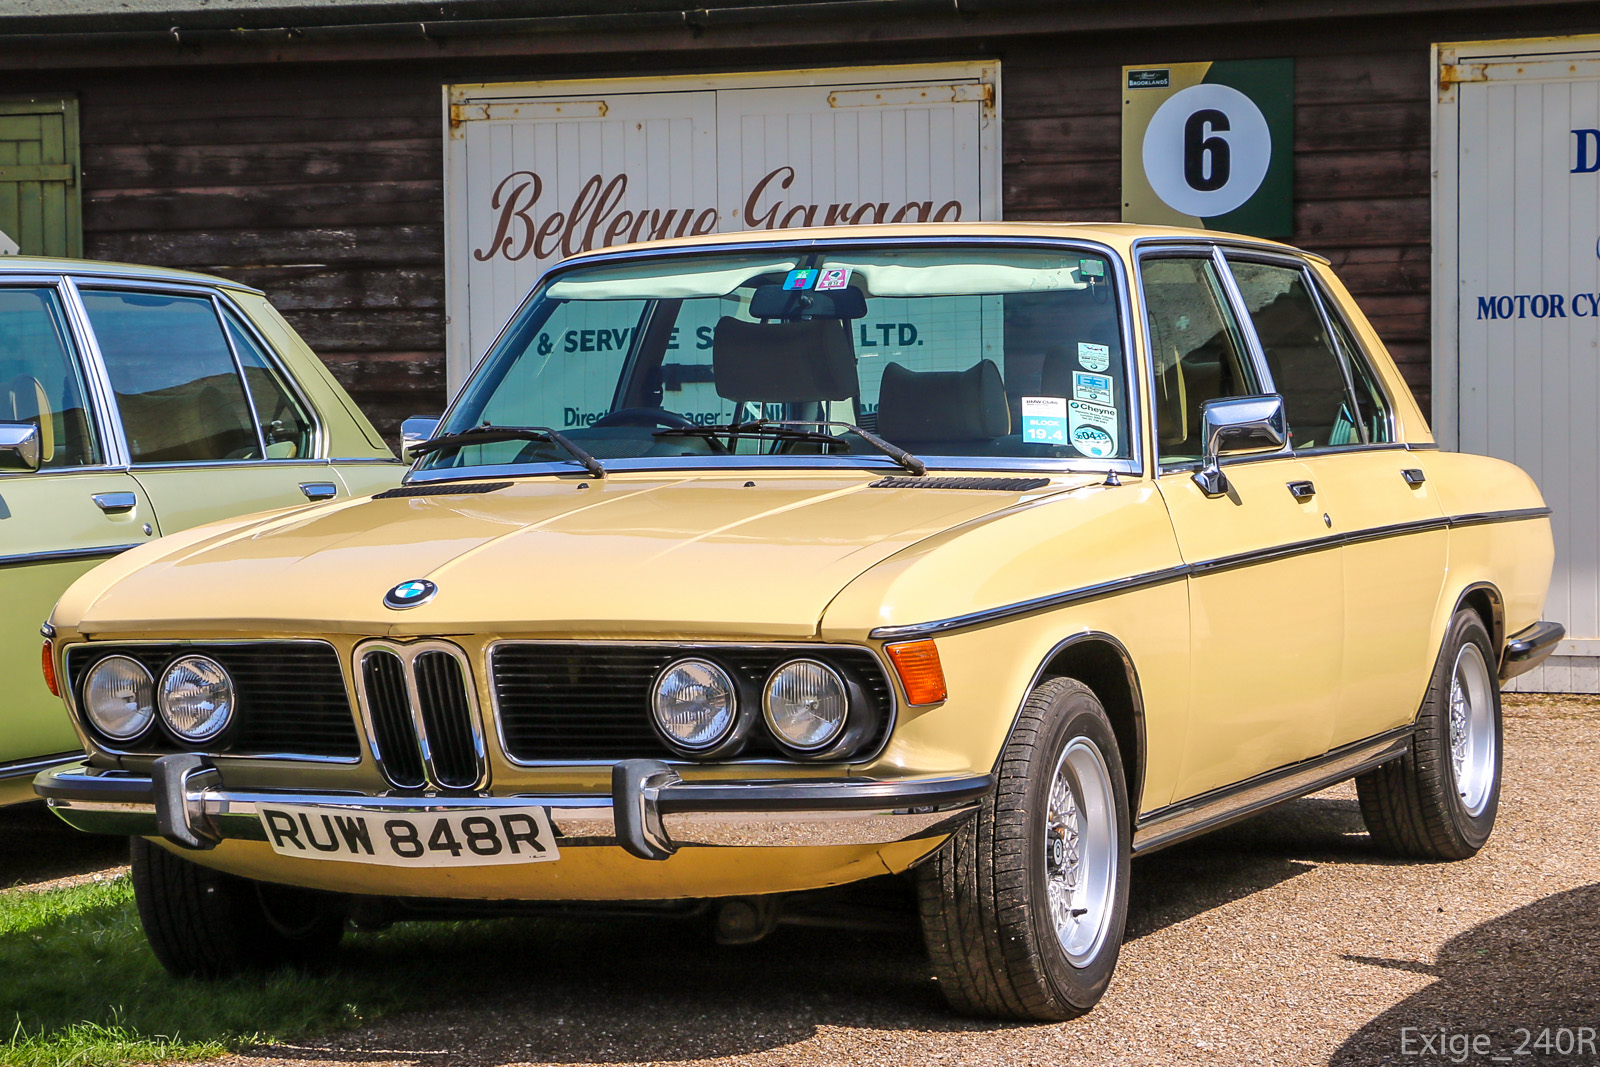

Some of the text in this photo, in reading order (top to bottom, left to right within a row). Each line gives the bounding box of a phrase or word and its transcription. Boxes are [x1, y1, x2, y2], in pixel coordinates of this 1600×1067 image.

[1184, 108, 1231, 192] 6
[474, 170, 717, 262] Bellevue
[1477, 294, 1567, 320] MOTOR
[537, 332, 554, 356] &
[564, 327, 680, 352] SERVE
[860, 323, 924, 347] LTD.
[1080, 403, 1115, 416] Cheyne
[1027, 428, 1064, 441] 19.4
[1030, 419, 1060, 427] BLOCK
[262, 809, 547, 859] RUW 848R
